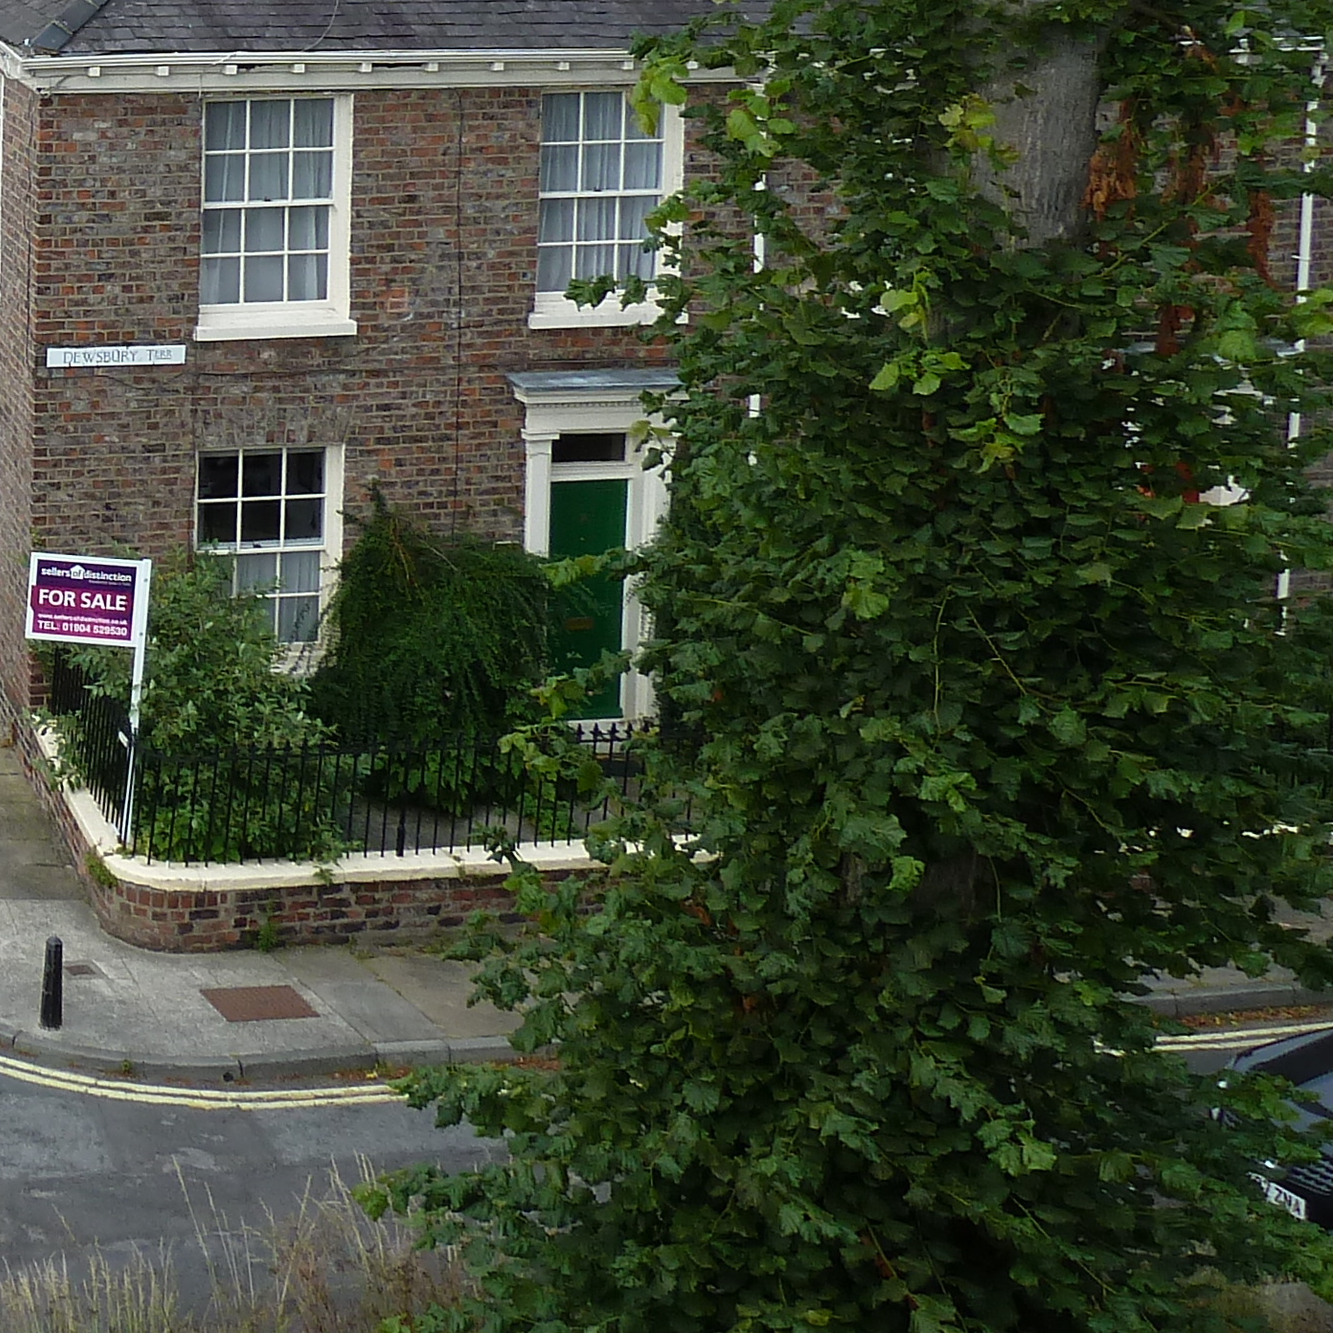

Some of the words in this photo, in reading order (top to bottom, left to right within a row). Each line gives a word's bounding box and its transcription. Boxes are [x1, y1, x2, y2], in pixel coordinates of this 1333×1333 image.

[62, 349, 139, 364] DEWSBURY
[40, 567, 71, 577] sellers
[72, 569, 82, 578] of
[83, 569, 132, 582] distinction
[38, 588, 76, 607] FOR
[80, 592, 127, 611] SALE
[62, 622, 91, 633] 01904
